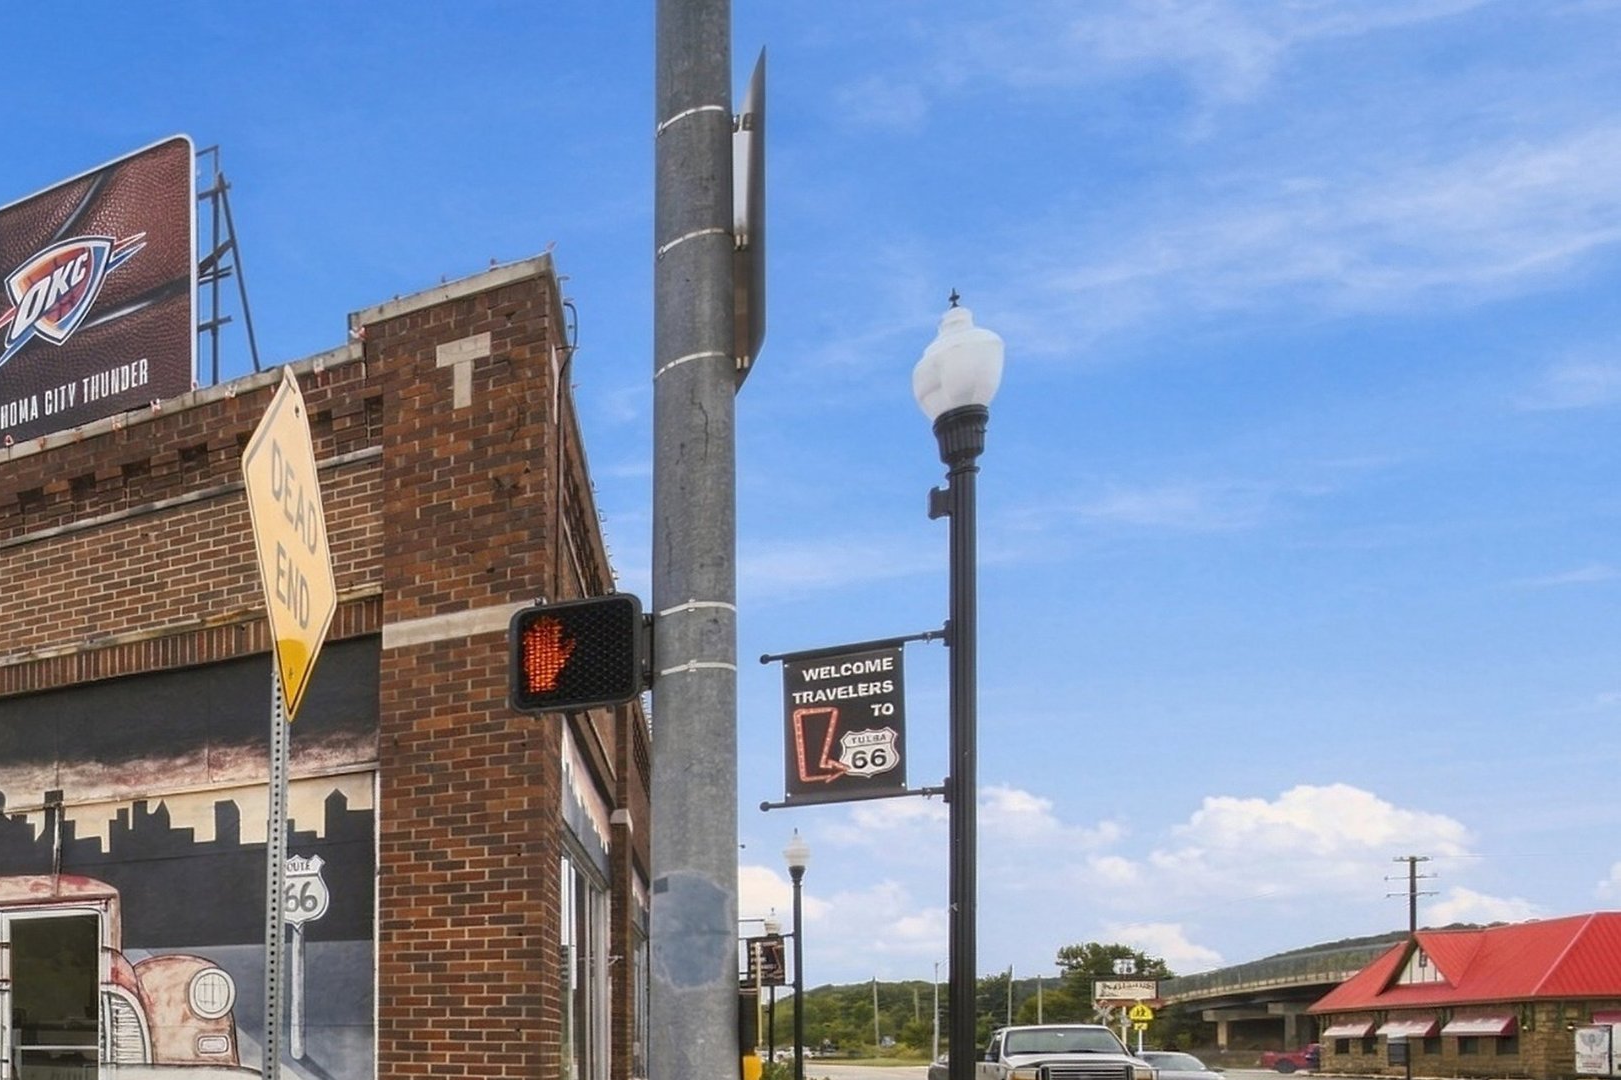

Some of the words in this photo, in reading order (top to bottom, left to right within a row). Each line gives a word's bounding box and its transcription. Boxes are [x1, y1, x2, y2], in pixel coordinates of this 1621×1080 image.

[11, 252, 89, 340] OKC
[45, 381, 76, 416] CITY
[82, 358, 149, 404] THUNDER
[271, 438, 318, 556] DEAD
[276, 540, 310, 630] END
[802, 657, 894, 682] WELCOME
[792, 680, 894, 705] TRAVELERS
[870, 703, 895, 717] TO
[851, 733, 887, 745] TULSA
[851, 748, 887, 769] 66
[287, 861, 311, 872] OUTE
[284, 881, 318, 913] 66
